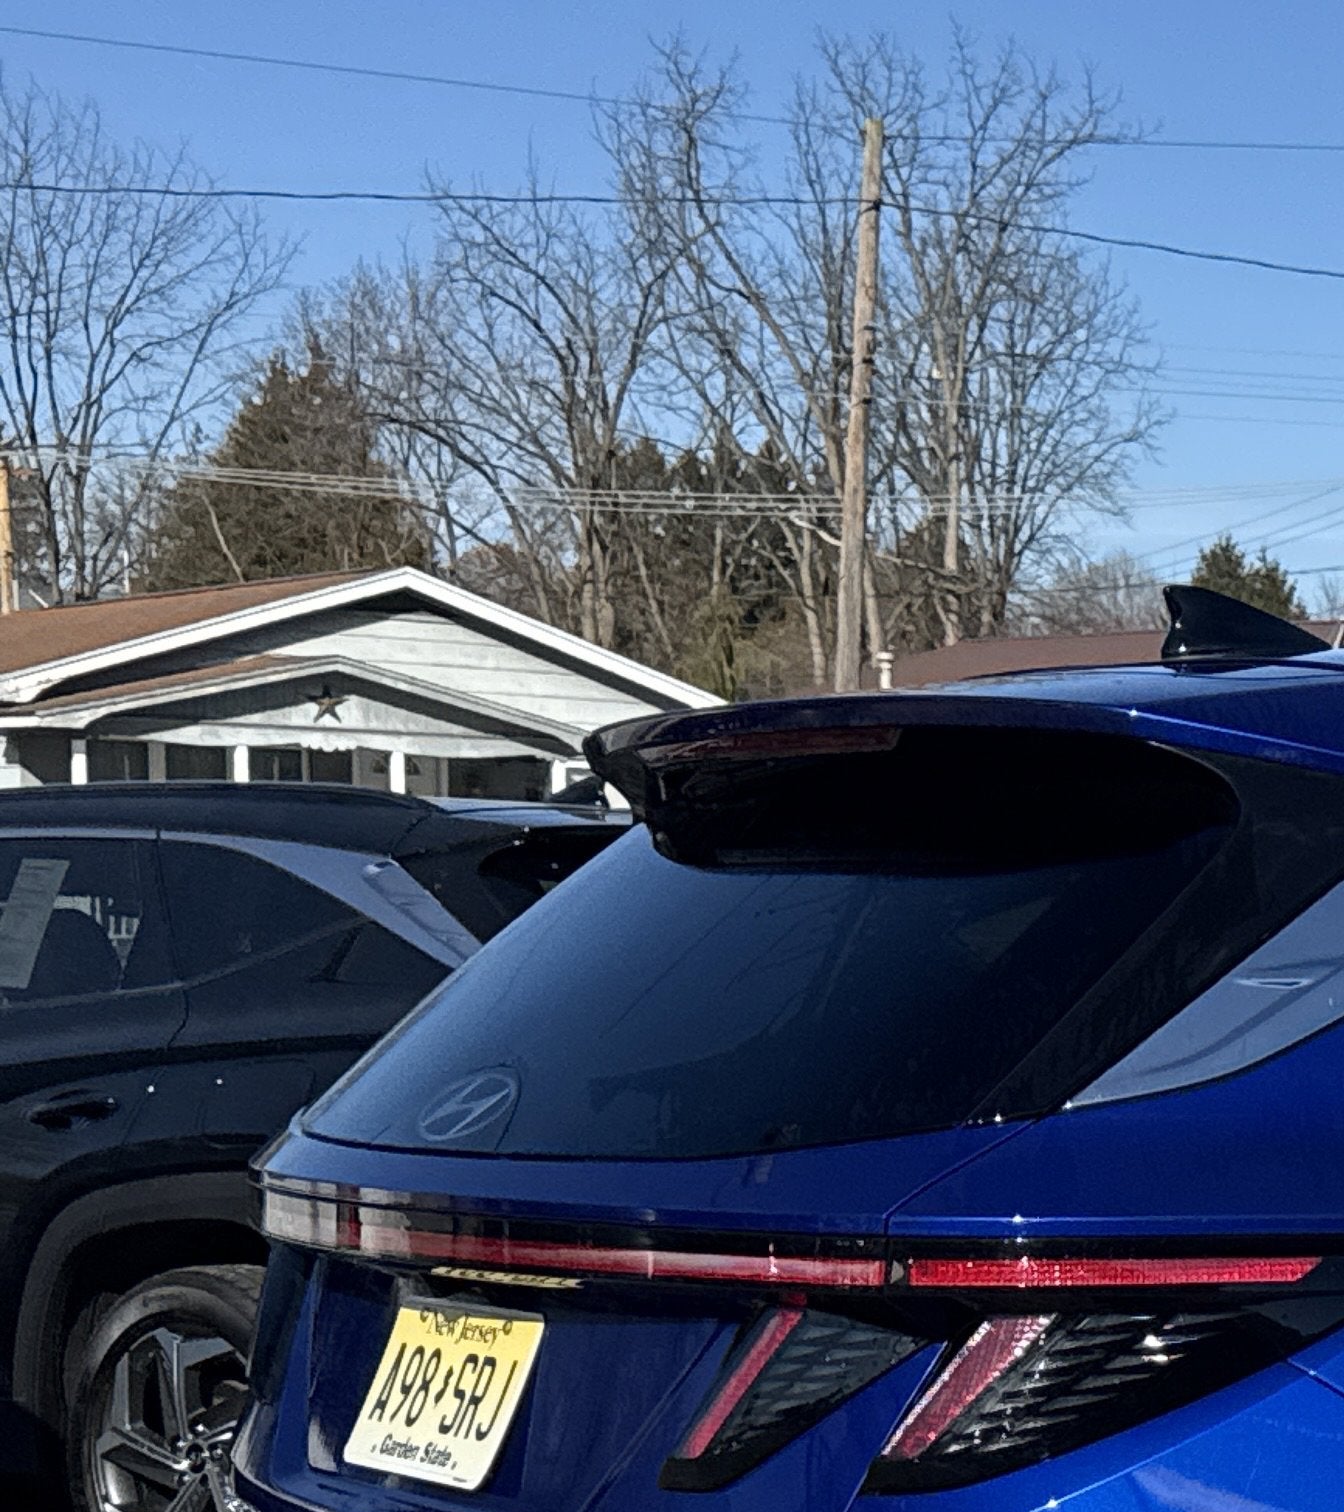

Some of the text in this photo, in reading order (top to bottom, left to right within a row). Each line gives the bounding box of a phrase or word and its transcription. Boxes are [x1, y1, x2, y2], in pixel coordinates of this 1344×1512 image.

[426, 1311, 499, 1349] New Jersey
[368, 1342, 518, 1442] A98 SRJ
[379, 1434, 453, 1468] Garden State
